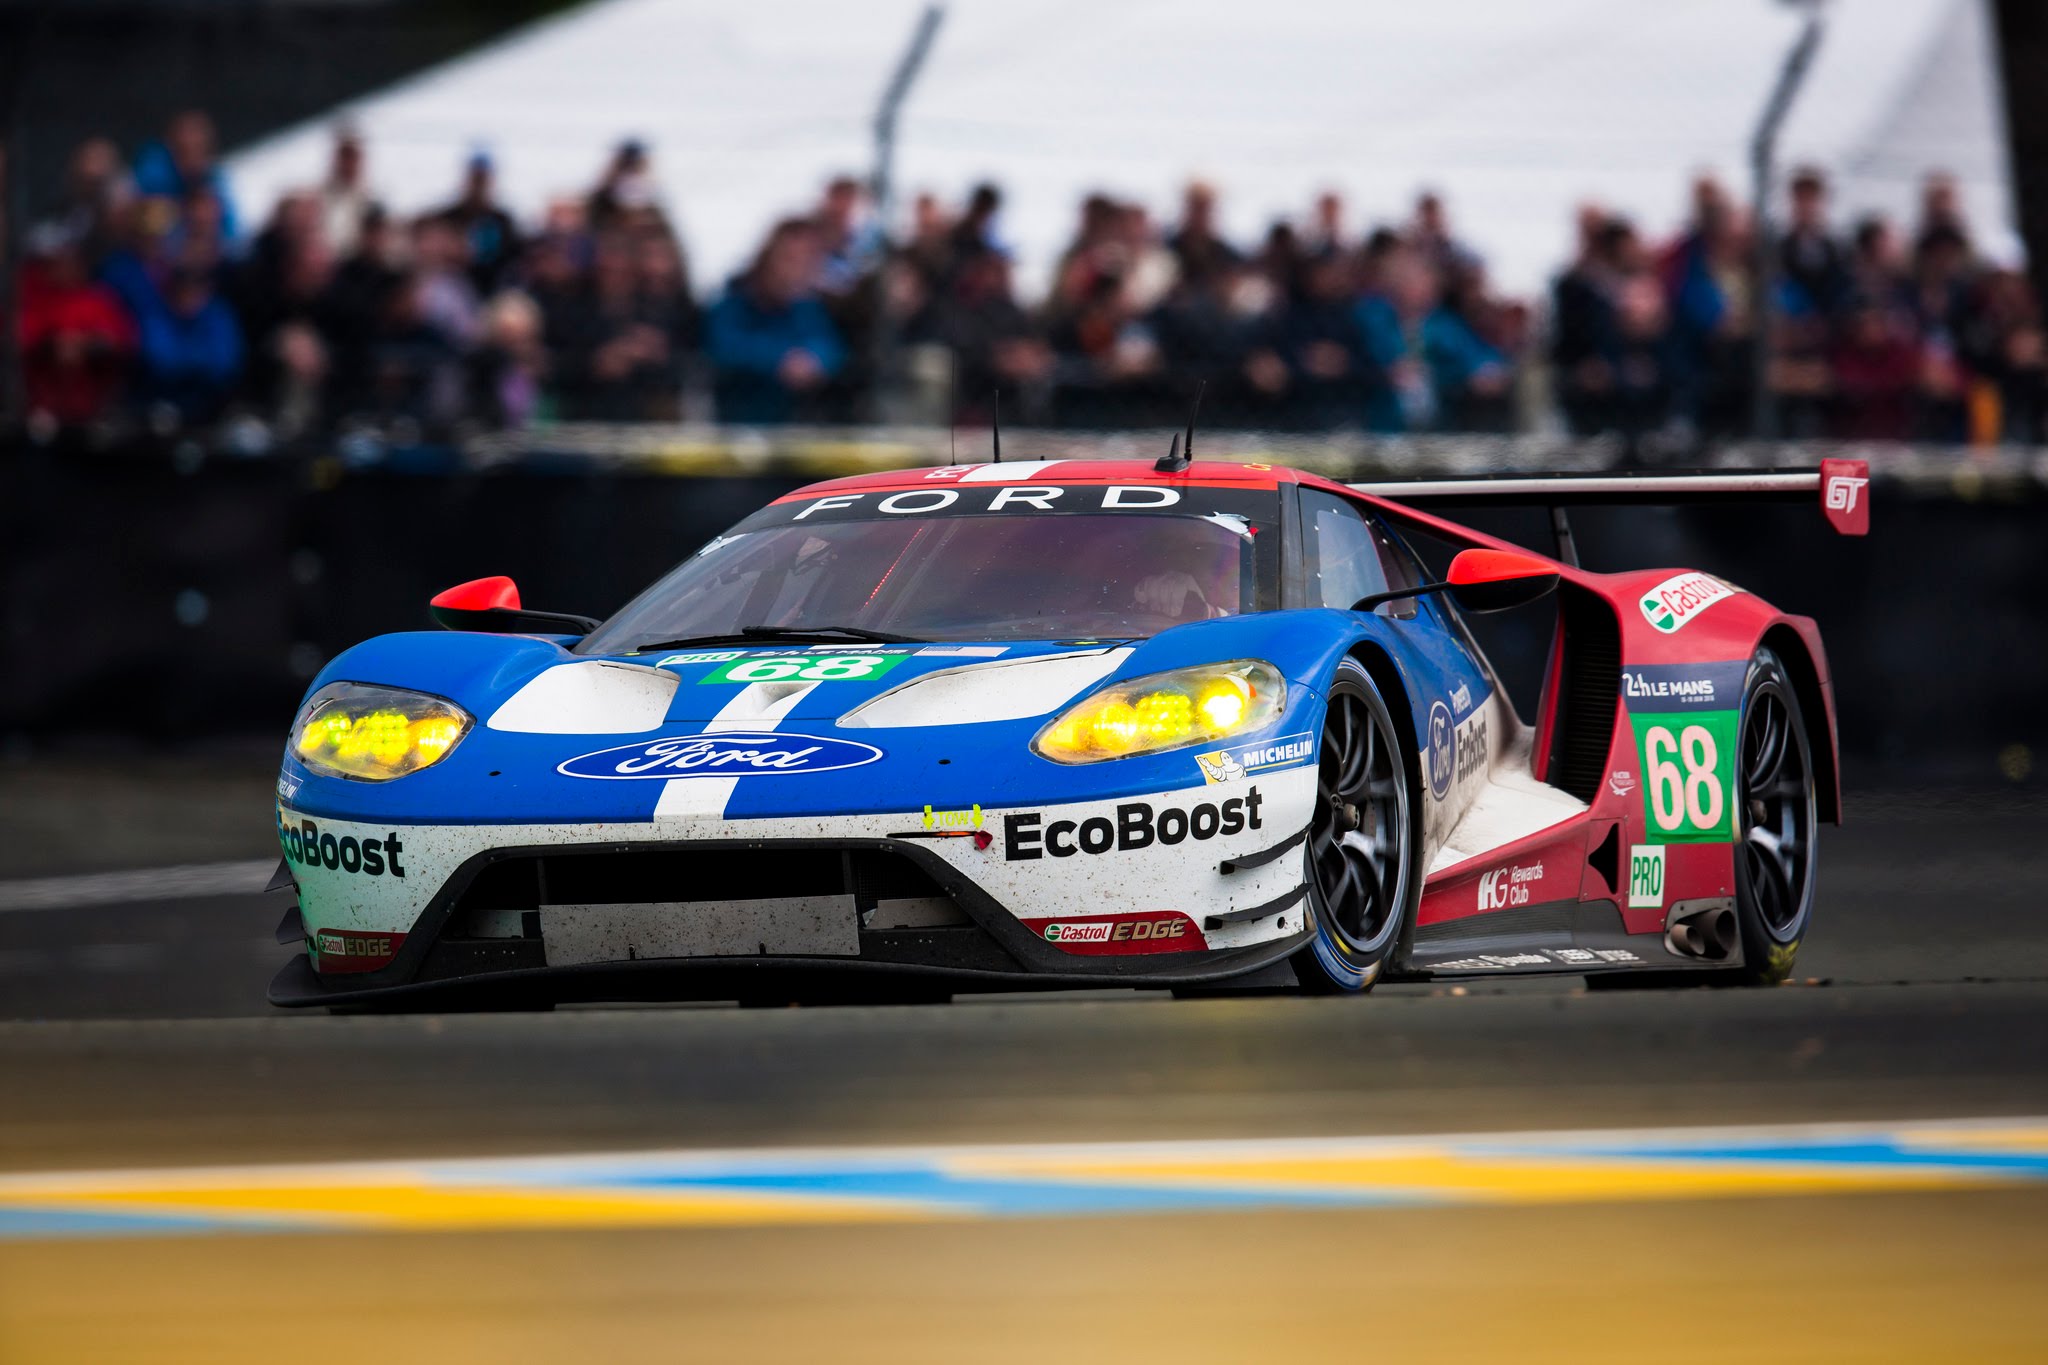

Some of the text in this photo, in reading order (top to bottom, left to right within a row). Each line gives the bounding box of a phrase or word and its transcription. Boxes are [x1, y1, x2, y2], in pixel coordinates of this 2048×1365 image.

[793, 486, 1181, 520] FORD
[1826, 476, 1869, 513] GT
[1660, 576, 1725, 616] Castrol
[726, 656, 884, 681] 68
[1651, 682, 1668, 696] LE
[1669, 680, 1714, 696] MANS
[615, 738, 823, 773] Ford
[1243, 740, 1313, 767] MICHELIN
[1434, 716, 1451, 784] Ford
[1645, 725, 1724, 830] 68
[936, 811, 969, 827] TOW
[1004, 785, 1263, 861] EcoBoost
[1511, 860, 1544, 884] Rewards
[1631, 855, 1662, 896] PRO
[1510, 884, 1529, 905] Club
[1060, 918, 1189, 941] Castrol EDGE
[345, 938, 392, 956] EDGE
